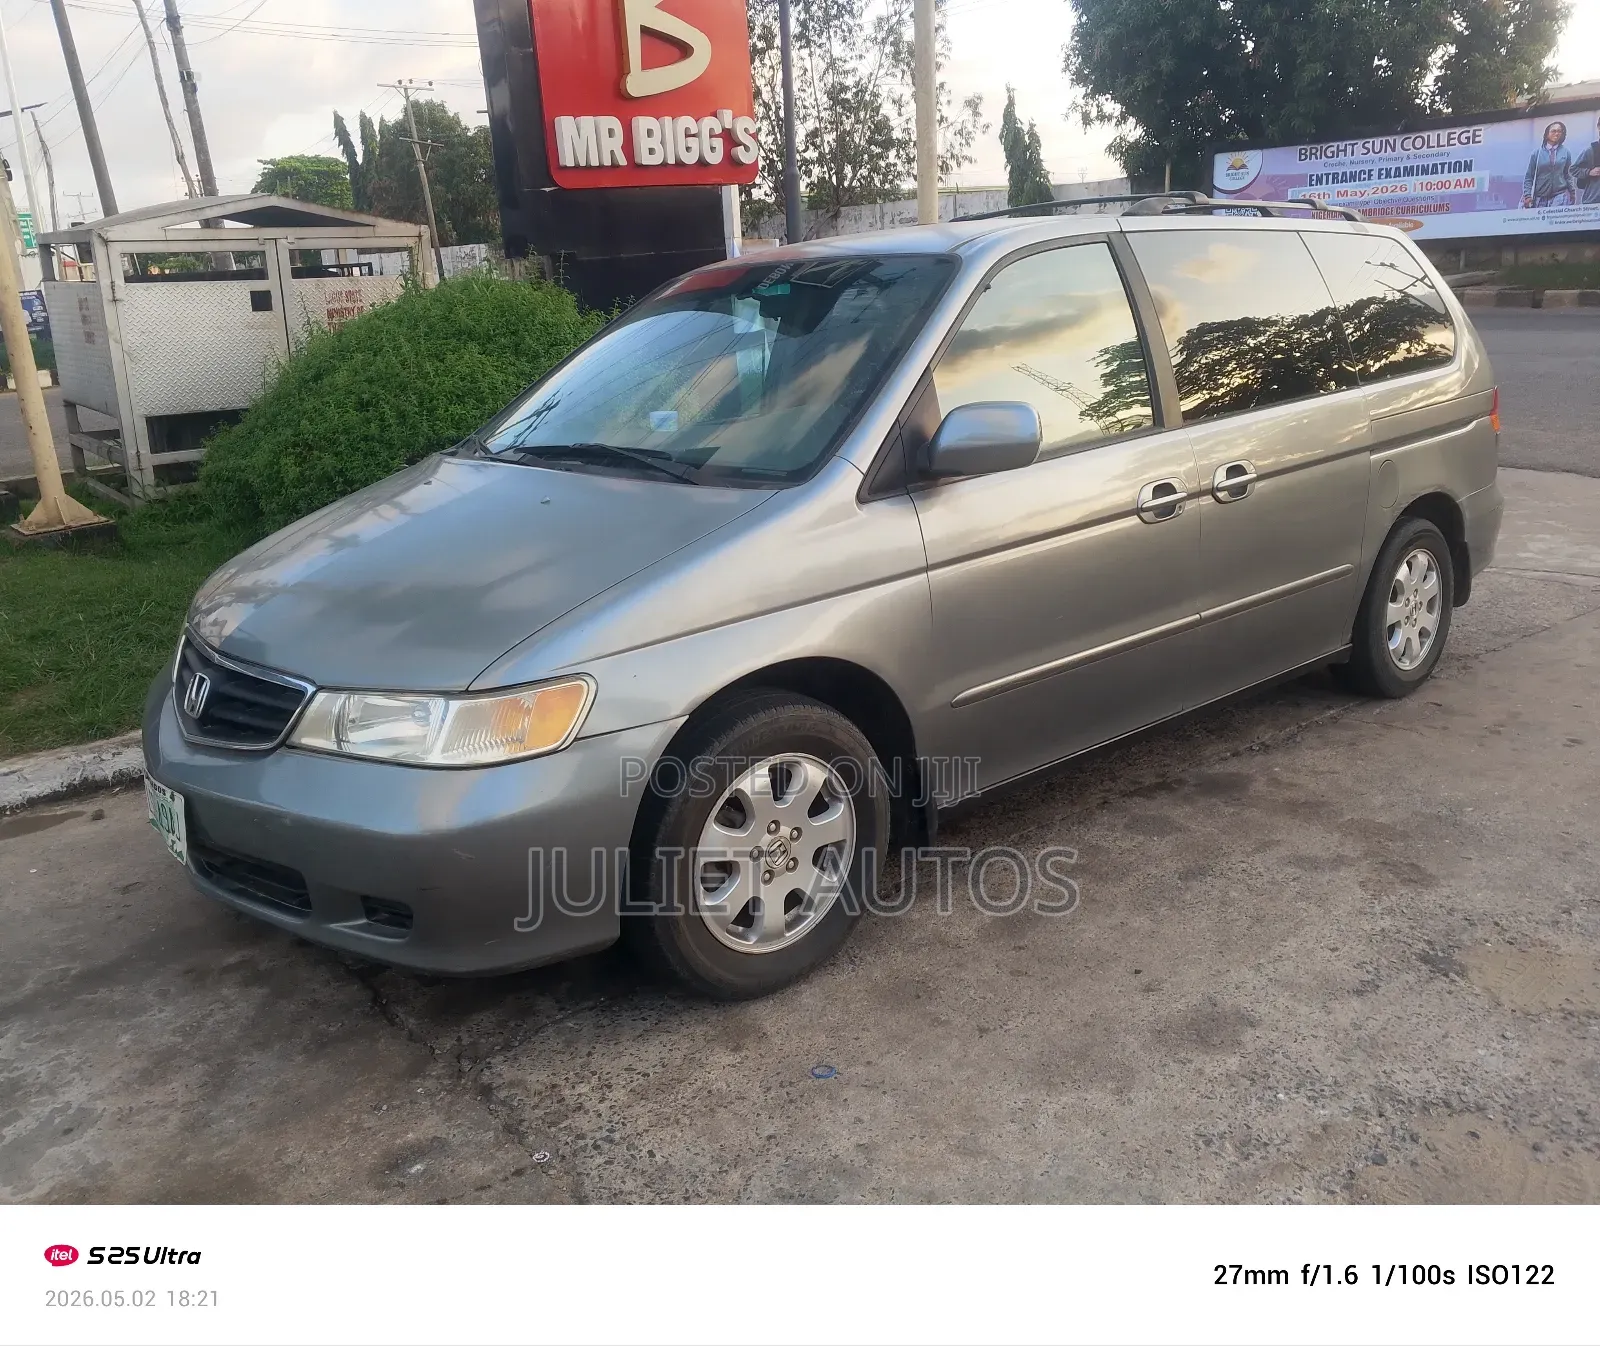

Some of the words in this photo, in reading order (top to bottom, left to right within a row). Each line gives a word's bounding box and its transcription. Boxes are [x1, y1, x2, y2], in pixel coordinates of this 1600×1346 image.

[555, 115, 627, 167] MR
[631, 109, 759, 166] BIGG'S
[1298, 142, 1358, 162] BRIGHT
[1361, 138, 1397, 156] SUN
[1401, 128, 1482, 152] COLLEGE
[1378, 155, 1404, 164] Primary
[1413, 150, 1451, 160] Secondary
[1308, 168, 1375, 187] ENTRANCE
[1378, 159, 1473, 181] EXAMINATION
[1453, 177, 1475, 189] AM
[1356, 206, 1396, 217] AMBRIDGE
[1396, 202, 1450, 215] CURRICULUMS
